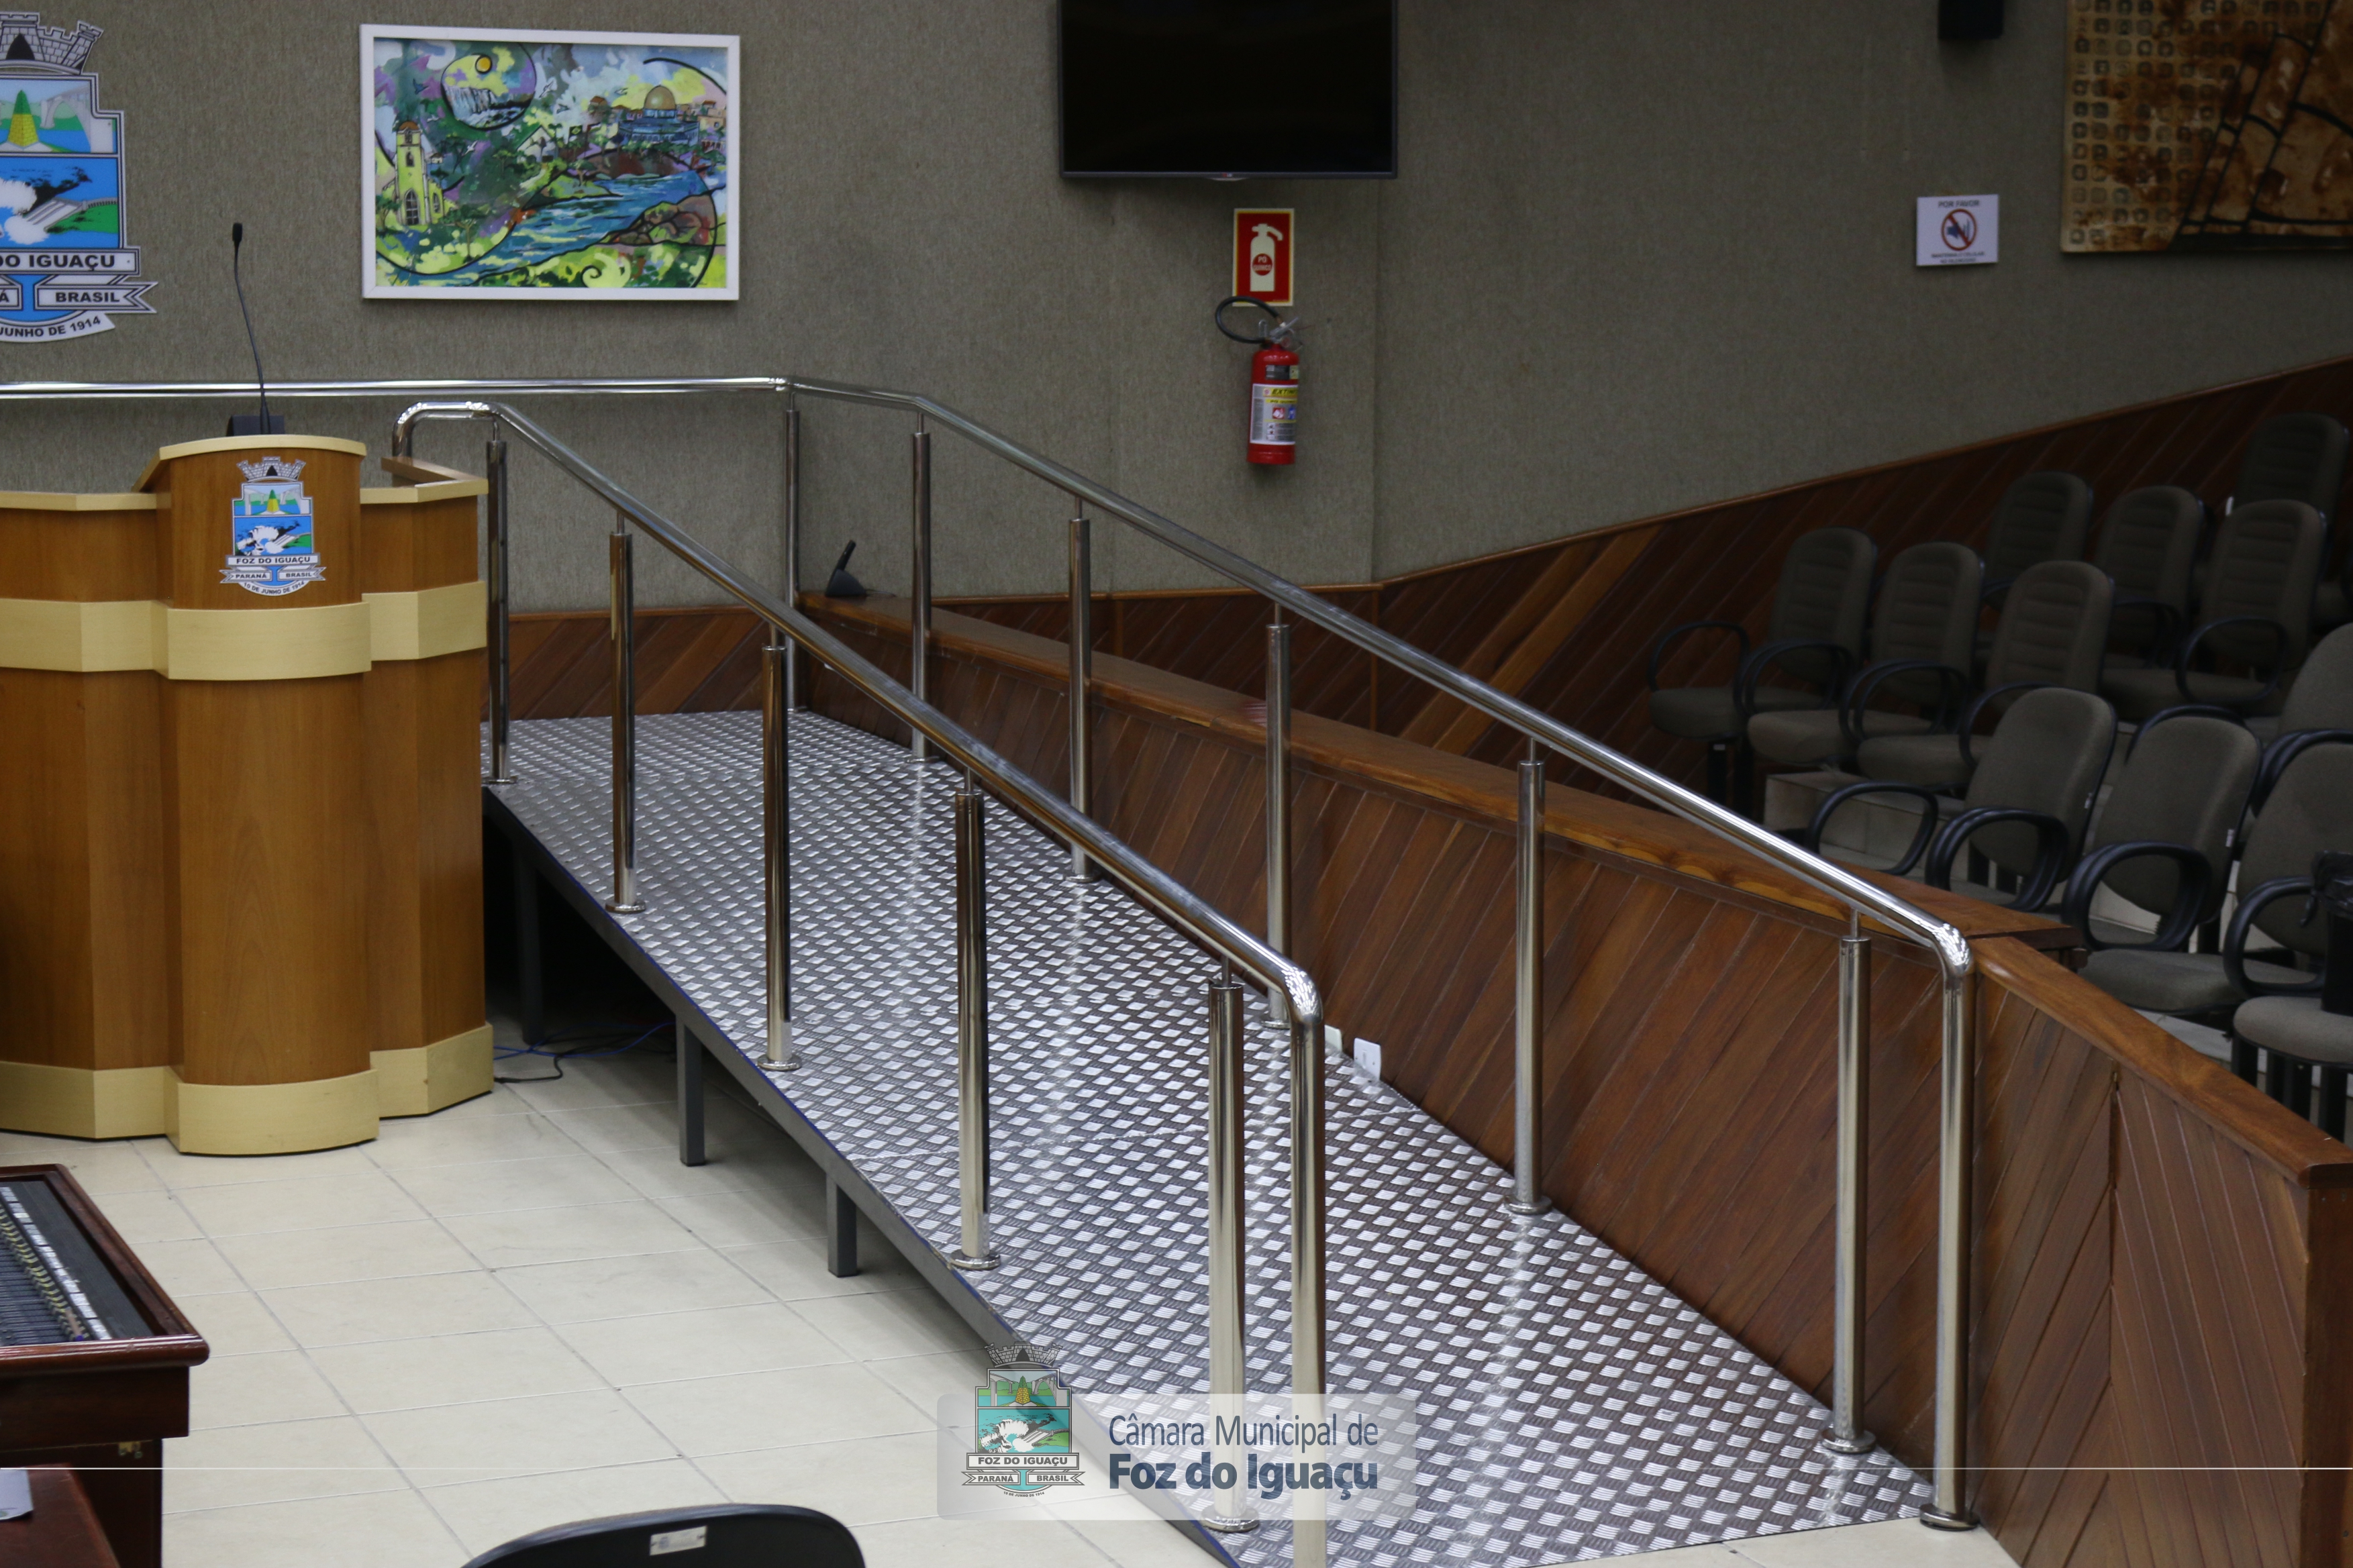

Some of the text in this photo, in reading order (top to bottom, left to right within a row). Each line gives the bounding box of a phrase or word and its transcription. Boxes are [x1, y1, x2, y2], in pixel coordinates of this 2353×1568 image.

[29, 255, 115, 271] IGUAÇU
[56, 293, 120, 303] BRASIL
[48, 325, 66, 336] DE
[70, 316, 101, 331] 1914
